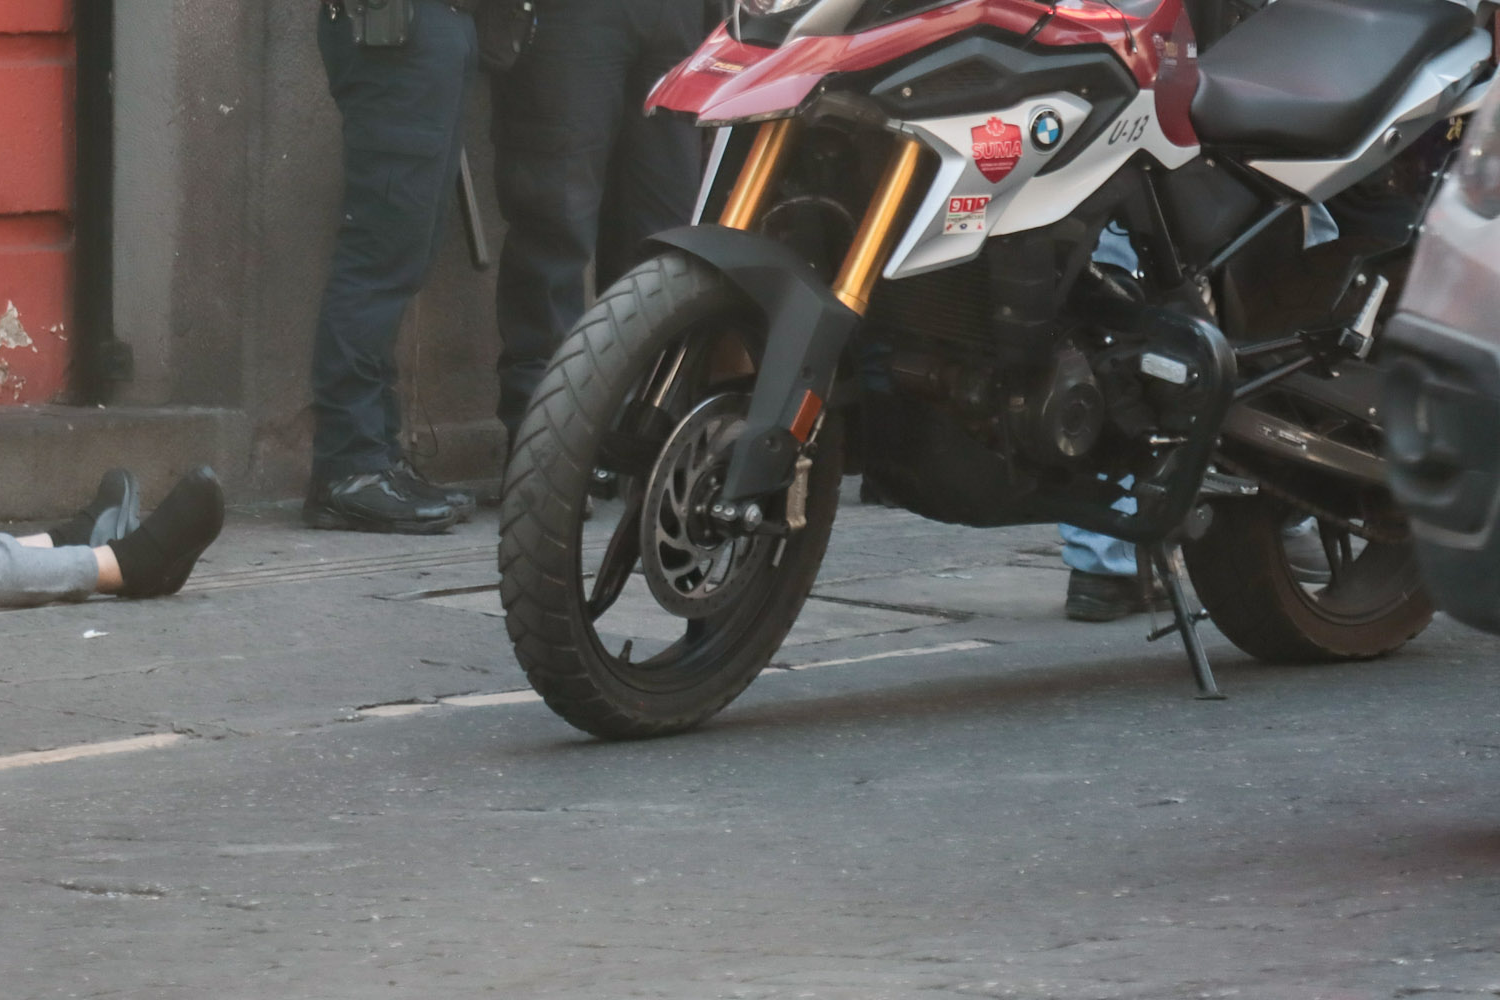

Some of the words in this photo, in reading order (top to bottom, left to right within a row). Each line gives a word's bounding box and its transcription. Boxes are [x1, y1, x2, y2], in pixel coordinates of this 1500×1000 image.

[1108, 114, 1150, 145] U-13
[971, 140, 1023, 160] SUMA
[951, 199, 986, 212] 911
